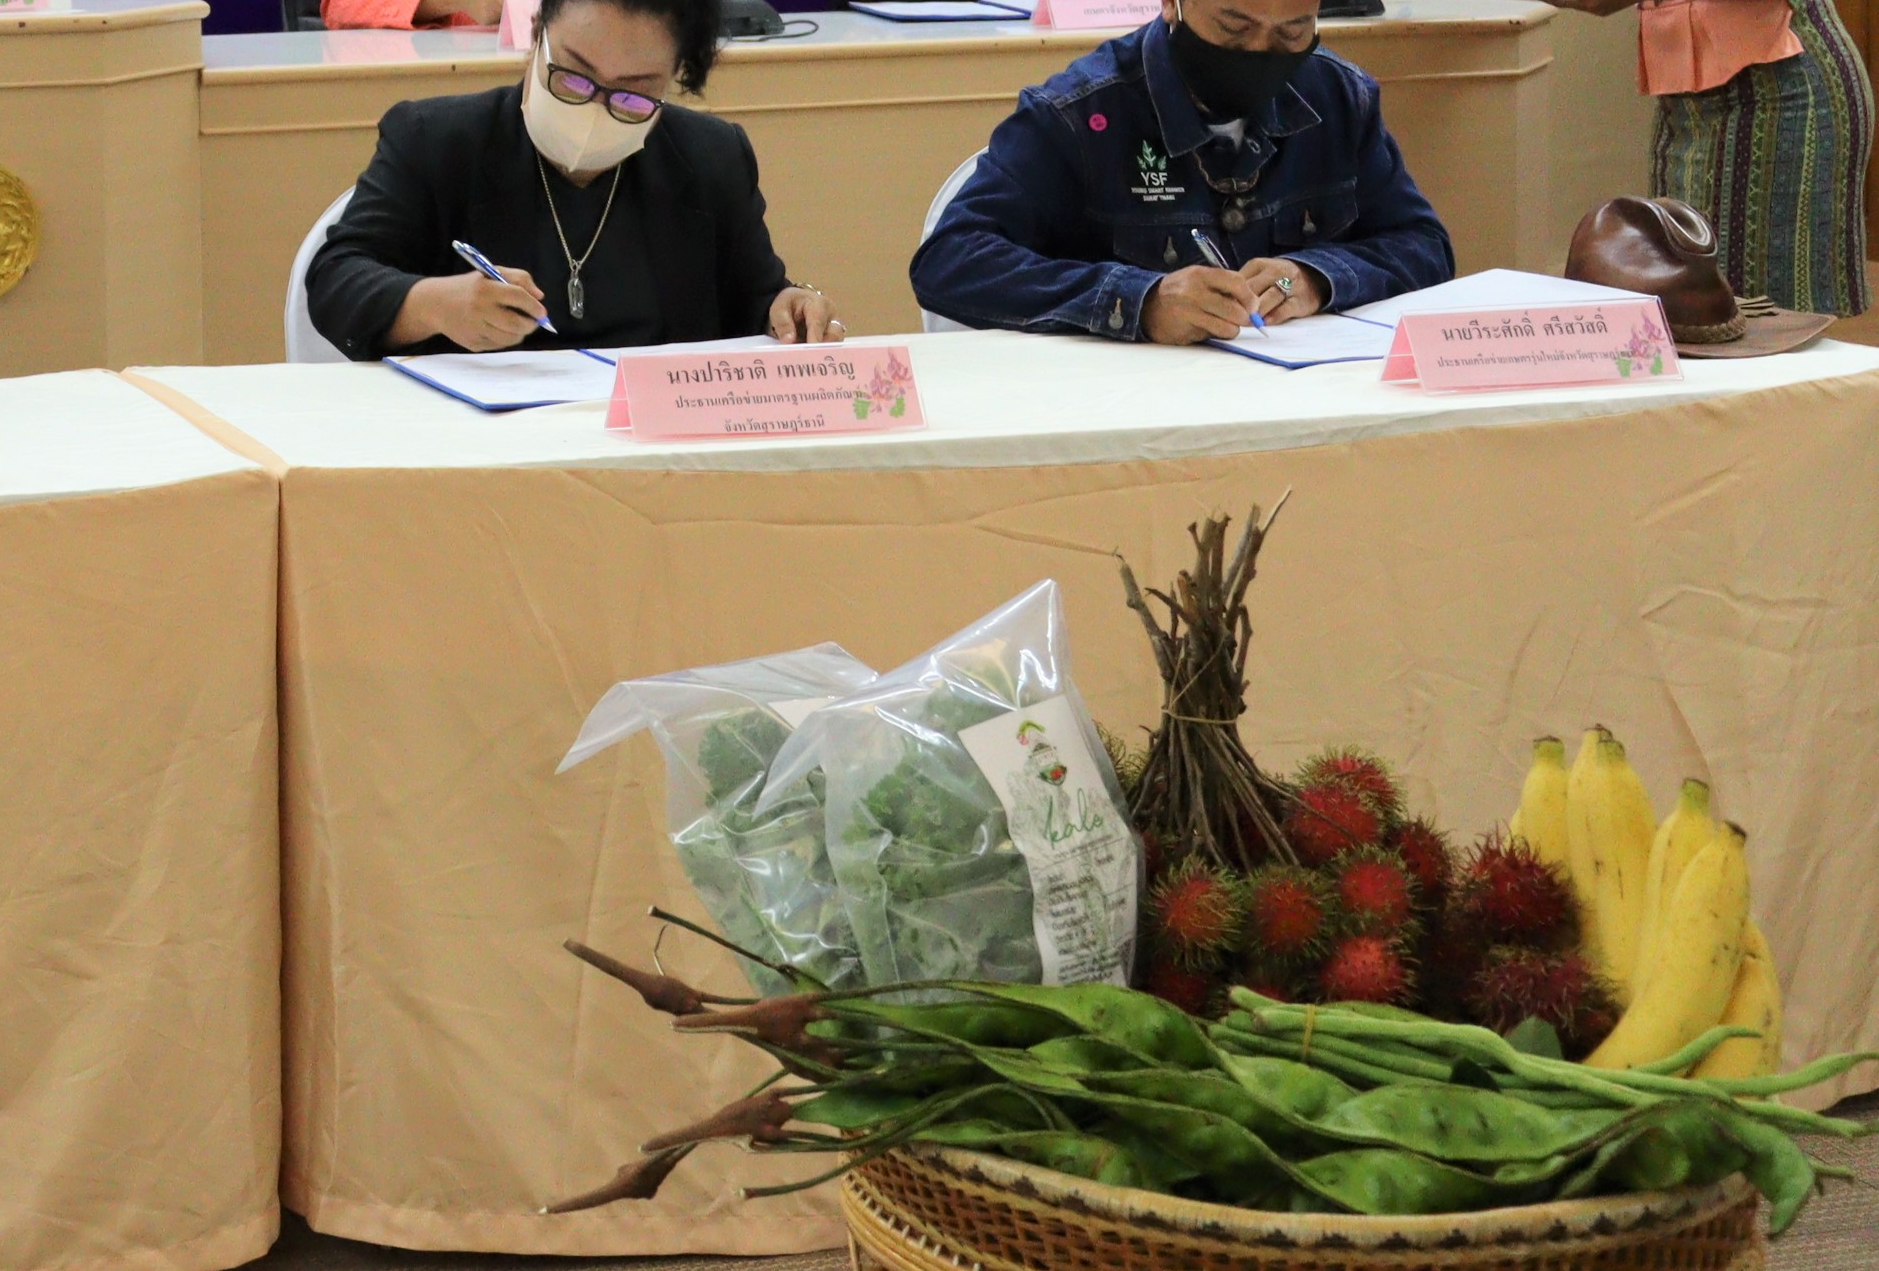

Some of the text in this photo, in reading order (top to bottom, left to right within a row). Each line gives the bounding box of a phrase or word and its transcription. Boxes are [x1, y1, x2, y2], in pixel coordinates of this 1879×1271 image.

[1140, 171, 1168, 187] YSF
[1441, 307, 1608, 342] นายวีระศักดิ์ ศรีสวัสดิ์
[666, 355, 856, 385] นางปาริชาติ เทพเจริญ
[724, 413, 825, 433] จังหวัดสุราษฎร์ธานี
